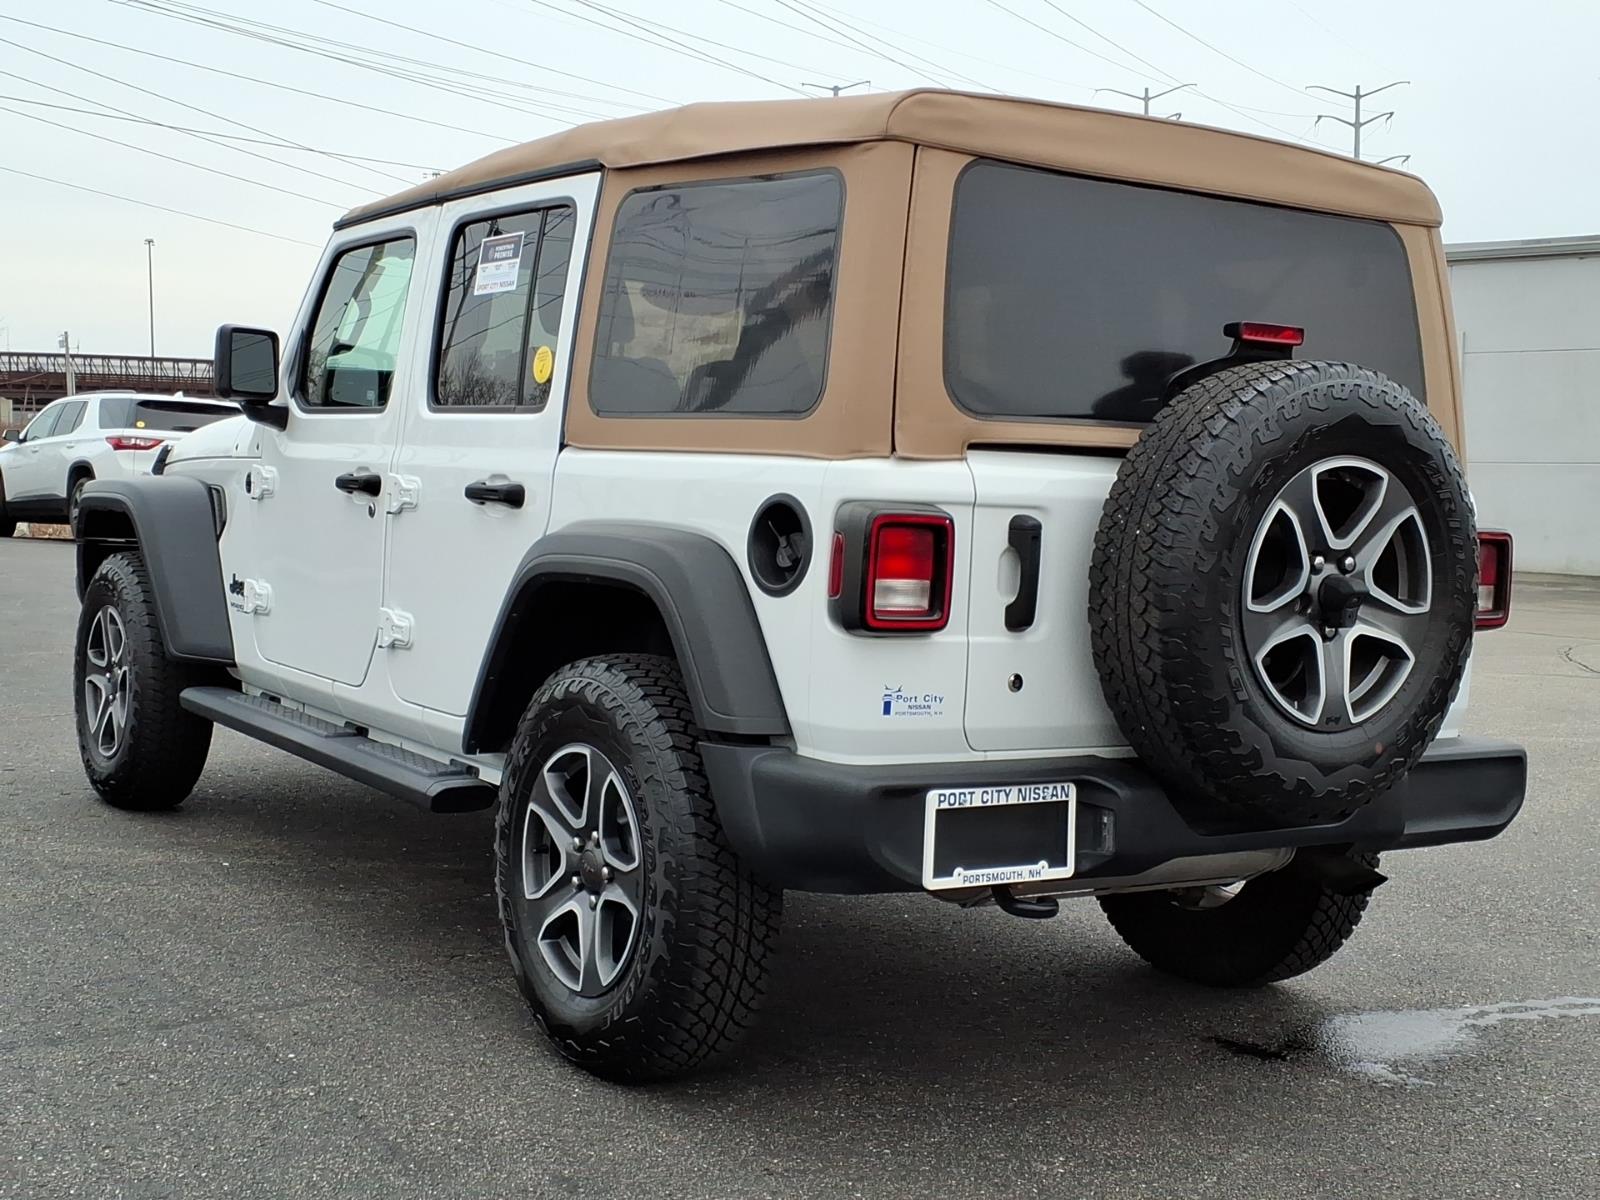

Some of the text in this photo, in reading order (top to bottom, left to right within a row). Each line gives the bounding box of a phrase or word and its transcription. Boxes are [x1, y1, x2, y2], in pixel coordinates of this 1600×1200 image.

[896, 694, 944, 704] Port City
[981, 788, 1013, 805] CITY
[1017, 784, 1071, 801] NISSAN
[962, 869, 1042, 885] PORTSMOUTH, NH
